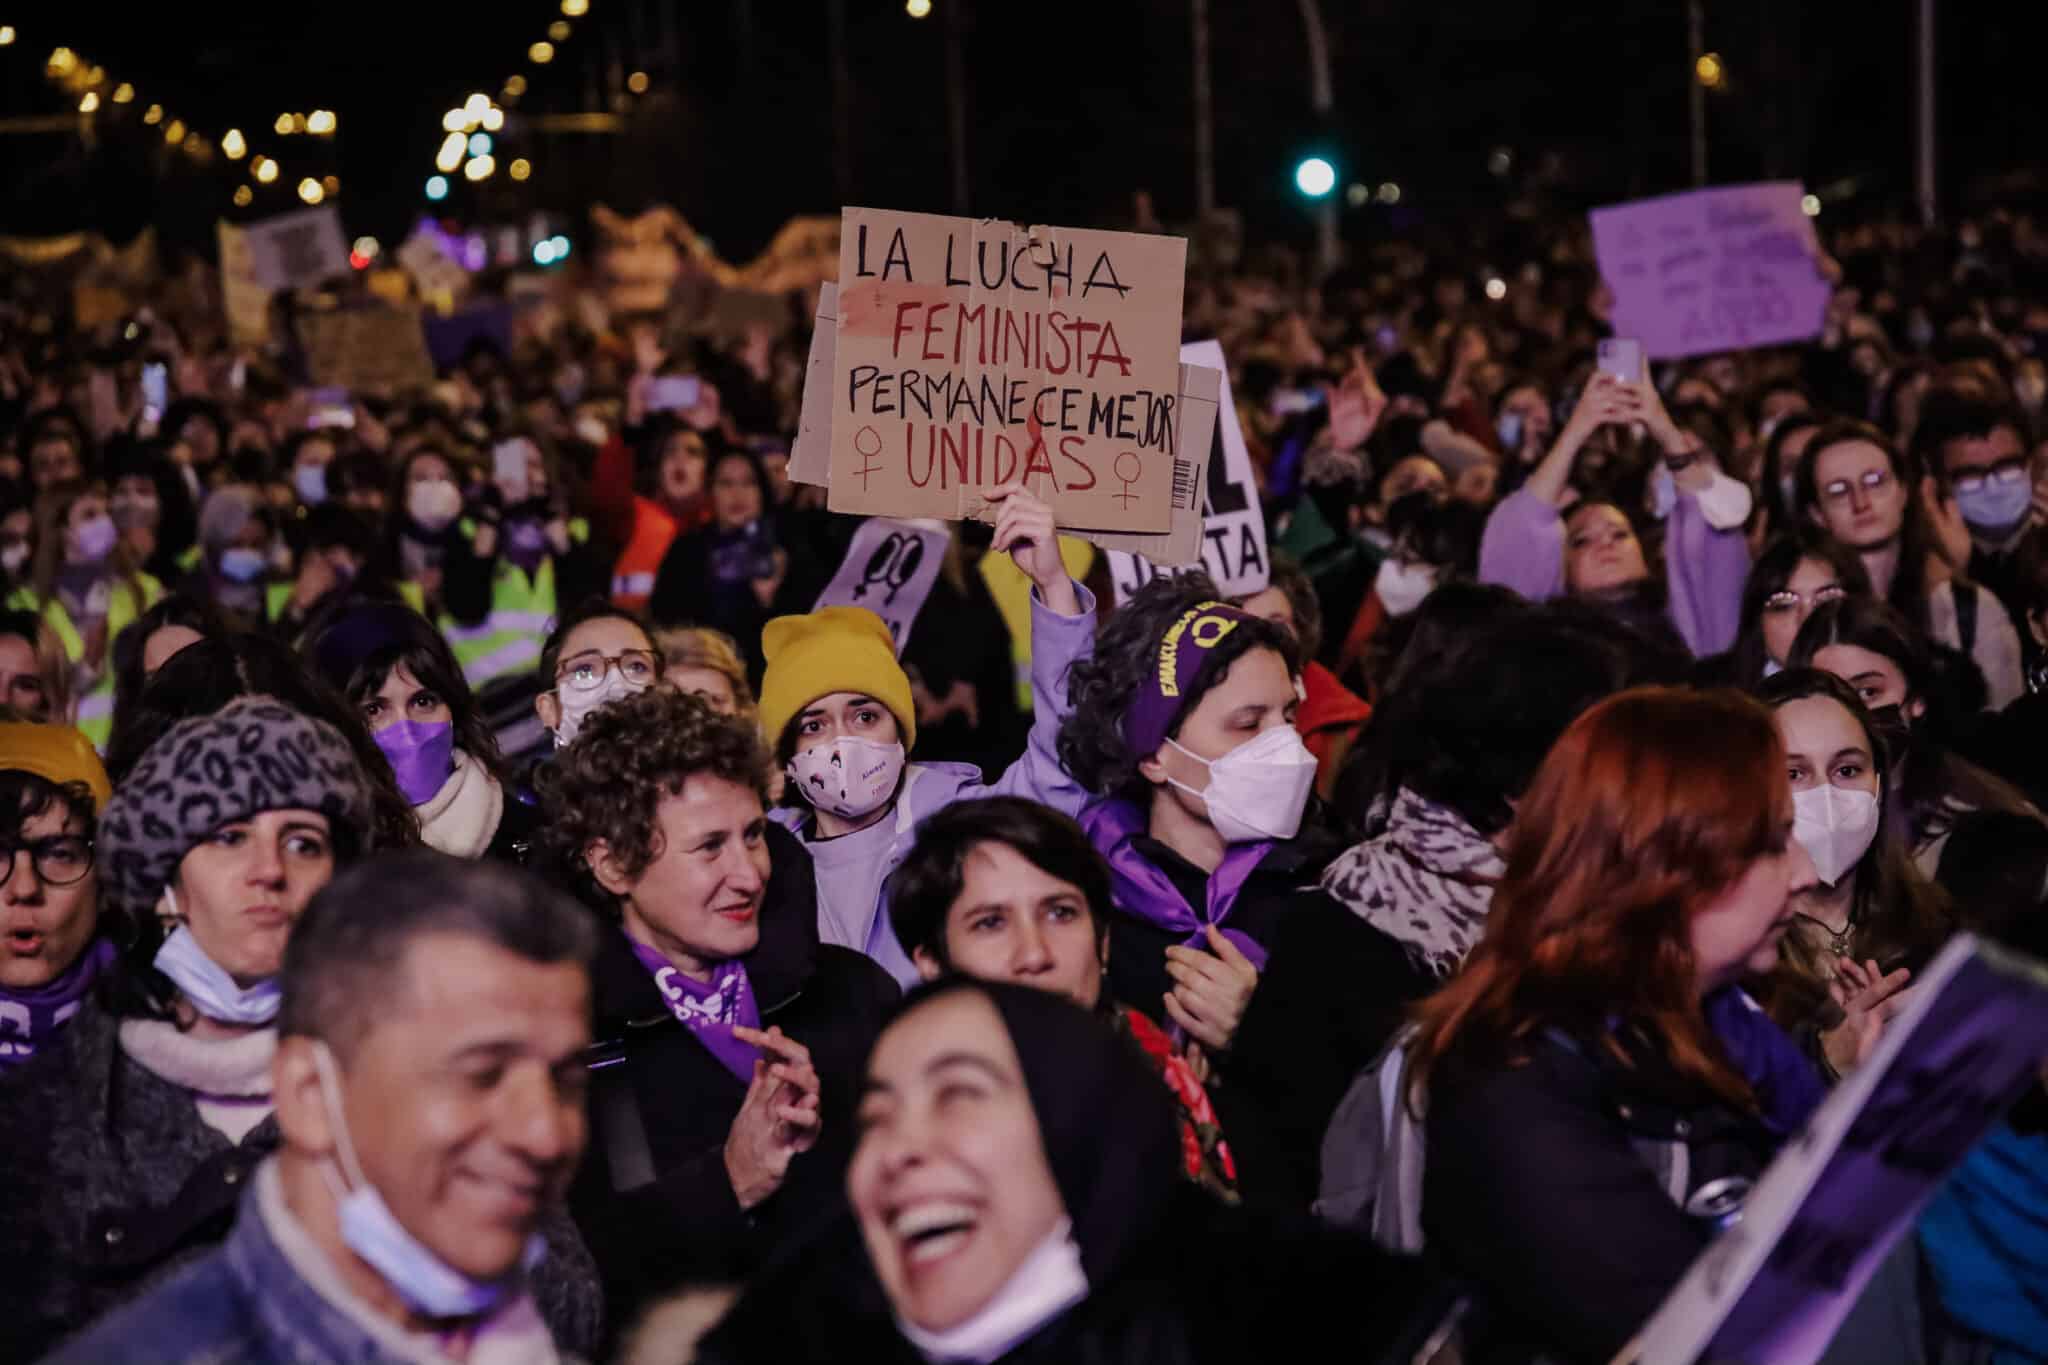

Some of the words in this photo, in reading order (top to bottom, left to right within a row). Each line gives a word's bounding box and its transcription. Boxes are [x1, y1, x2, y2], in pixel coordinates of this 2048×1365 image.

[856, 225, 913, 282] LA
[945, 233, 1133, 299] LUCHA
[892, 302, 1132, 379] FEMINISTA
[849, 365, 1083, 431] PERMANECE
[1087, 390, 1176, 456] MEJOR
[907, 422, 1097, 494] UNIDAS
